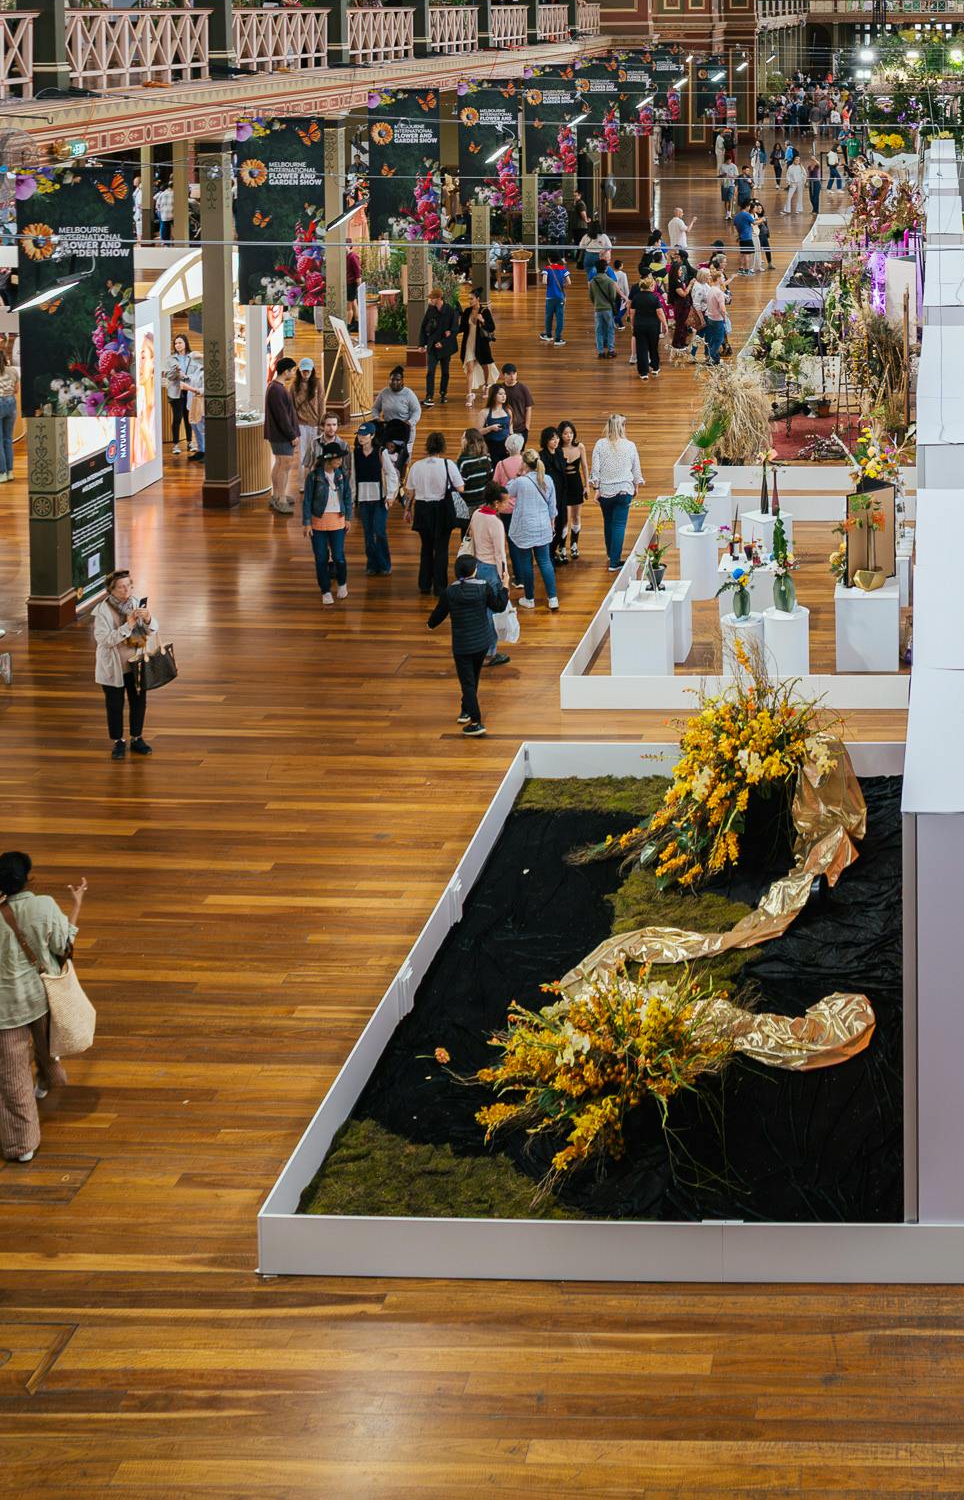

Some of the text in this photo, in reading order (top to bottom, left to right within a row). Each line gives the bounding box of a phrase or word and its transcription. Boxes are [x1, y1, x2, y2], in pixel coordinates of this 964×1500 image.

[58, 226, 110, 234] MELBOURNE
[100, 241, 121, 249] AND
[100, 249, 130, 257] SHOW
[119, 424, 127, 458] NATURAL
